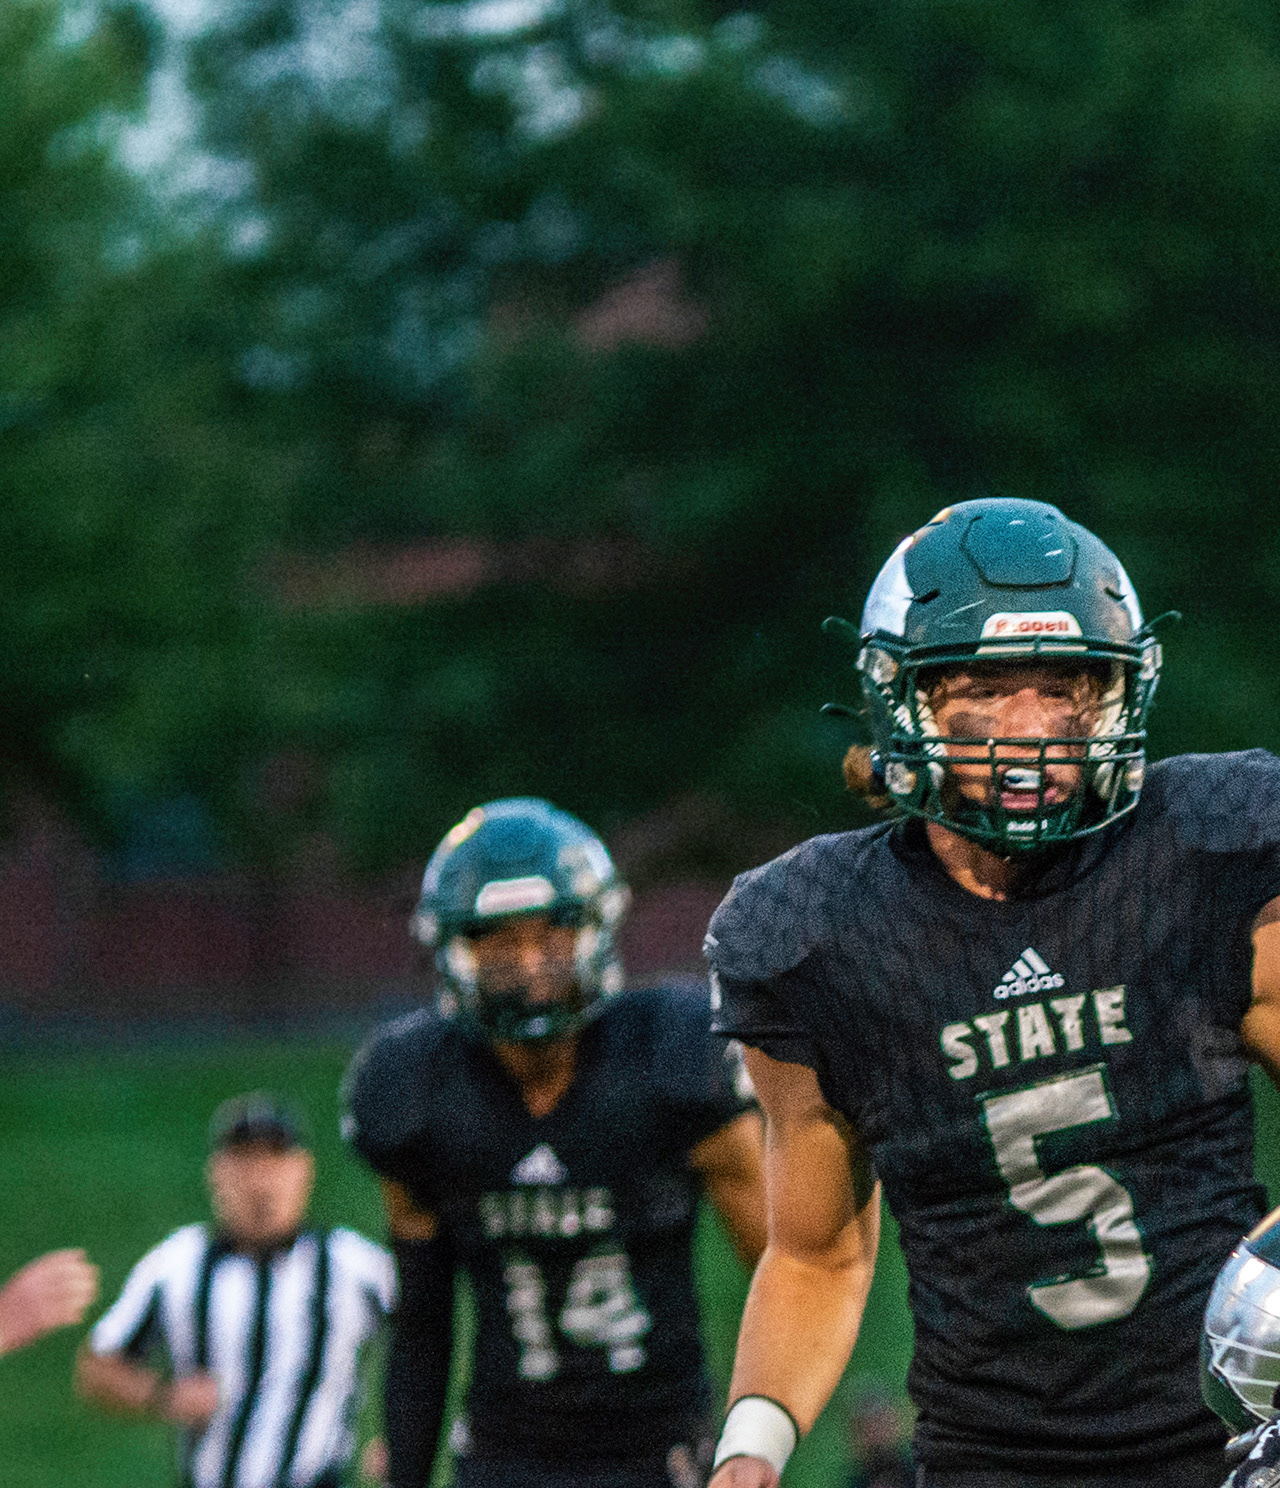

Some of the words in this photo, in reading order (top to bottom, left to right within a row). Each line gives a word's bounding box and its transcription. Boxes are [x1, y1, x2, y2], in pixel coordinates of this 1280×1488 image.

[939, 984, 1135, 1081] STATE
[993, 972, 1066, 1000] adidas
[975, 1062, 1153, 1331] 5
[504, 1252, 653, 1382] 14
